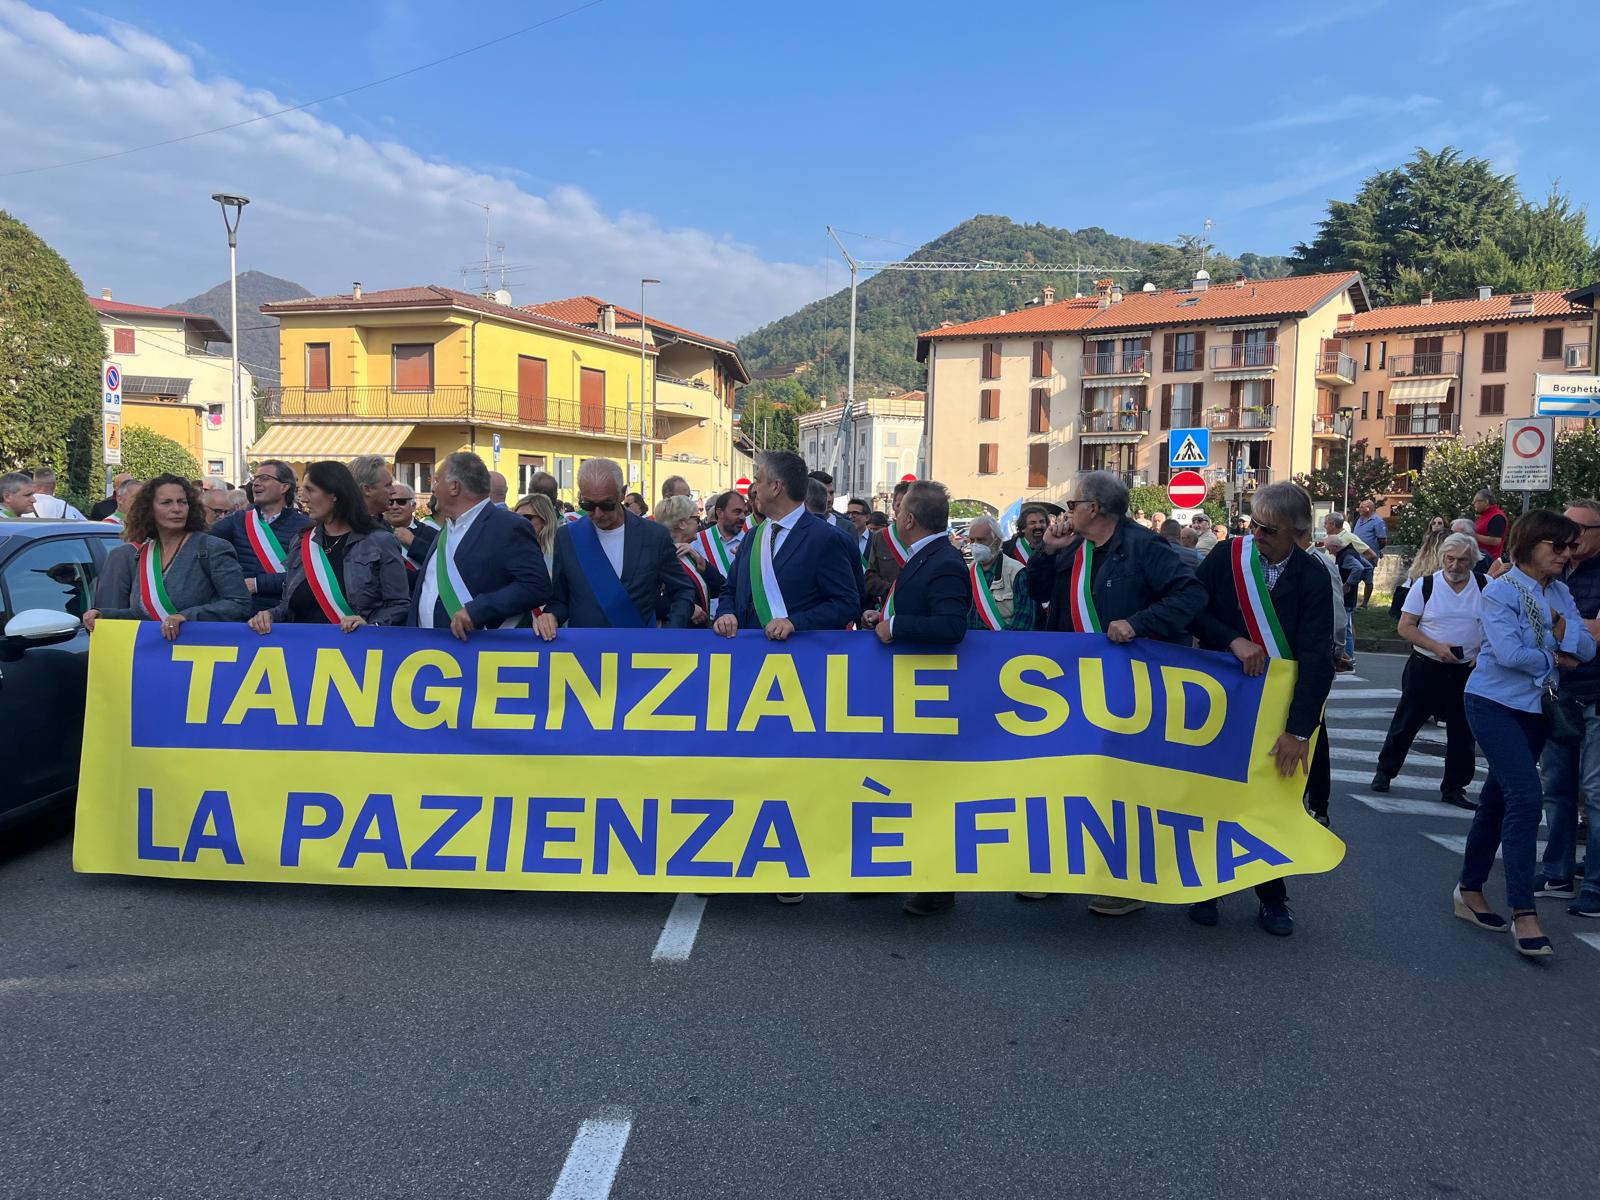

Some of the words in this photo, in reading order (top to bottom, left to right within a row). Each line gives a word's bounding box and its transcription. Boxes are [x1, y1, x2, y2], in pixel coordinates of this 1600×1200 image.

[171, 645, 959, 735] TANGENZIALE
[995, 654, 1228, 747] SUD
[137, 788, 245, 865] LA
[280, 791, 811, 878] PAZIENZA
[850, 775, 912, 878] È
[955, 796, 1294, 887] FINITA
